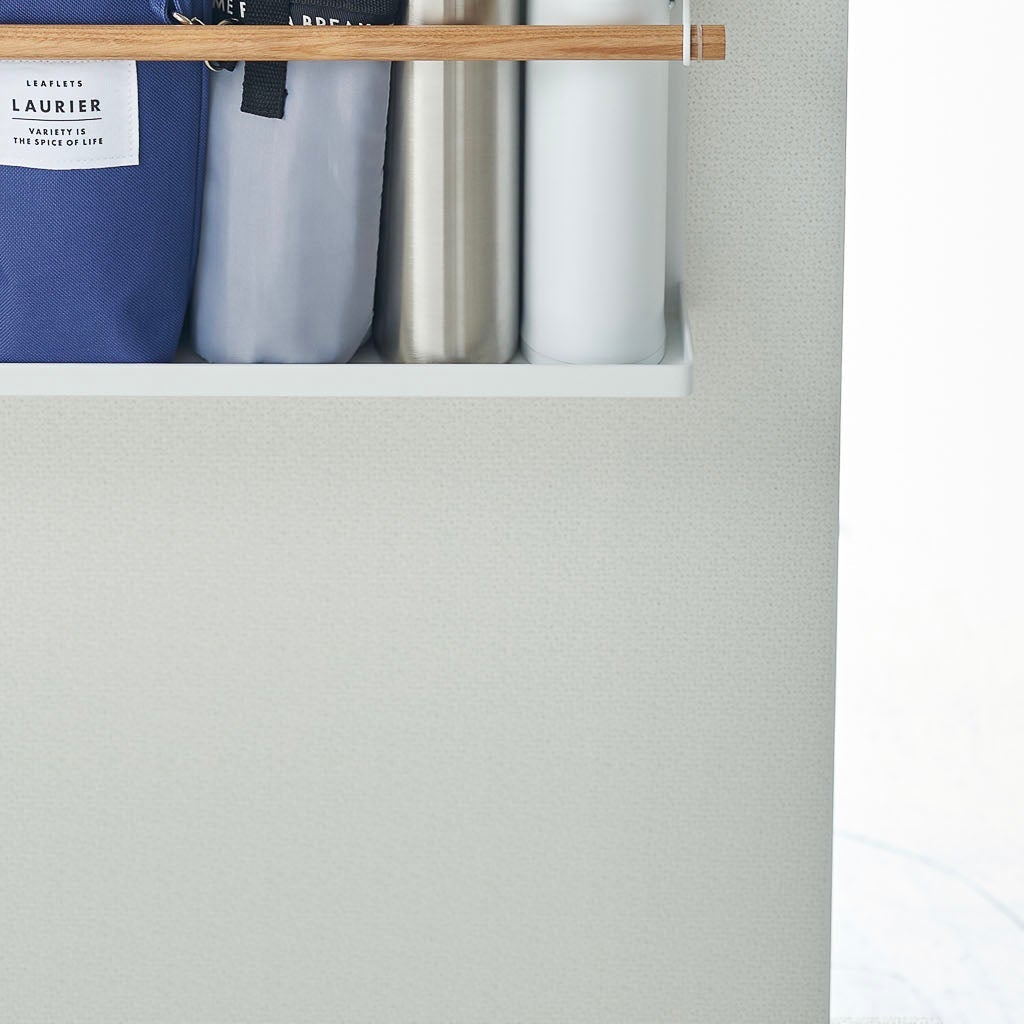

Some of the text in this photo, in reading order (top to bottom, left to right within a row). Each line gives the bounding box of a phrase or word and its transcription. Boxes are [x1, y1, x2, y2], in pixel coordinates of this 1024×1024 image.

[26, 79, 83, 87] LEAFLETS
[12, 98, 101, 113] LAURIER
[28, 127, 73, 135] VARIETY
[13, 137, 31, 145] THE
[34, 138, 62, 146] SPICE
[82, 137, 103, 145] LIFE
